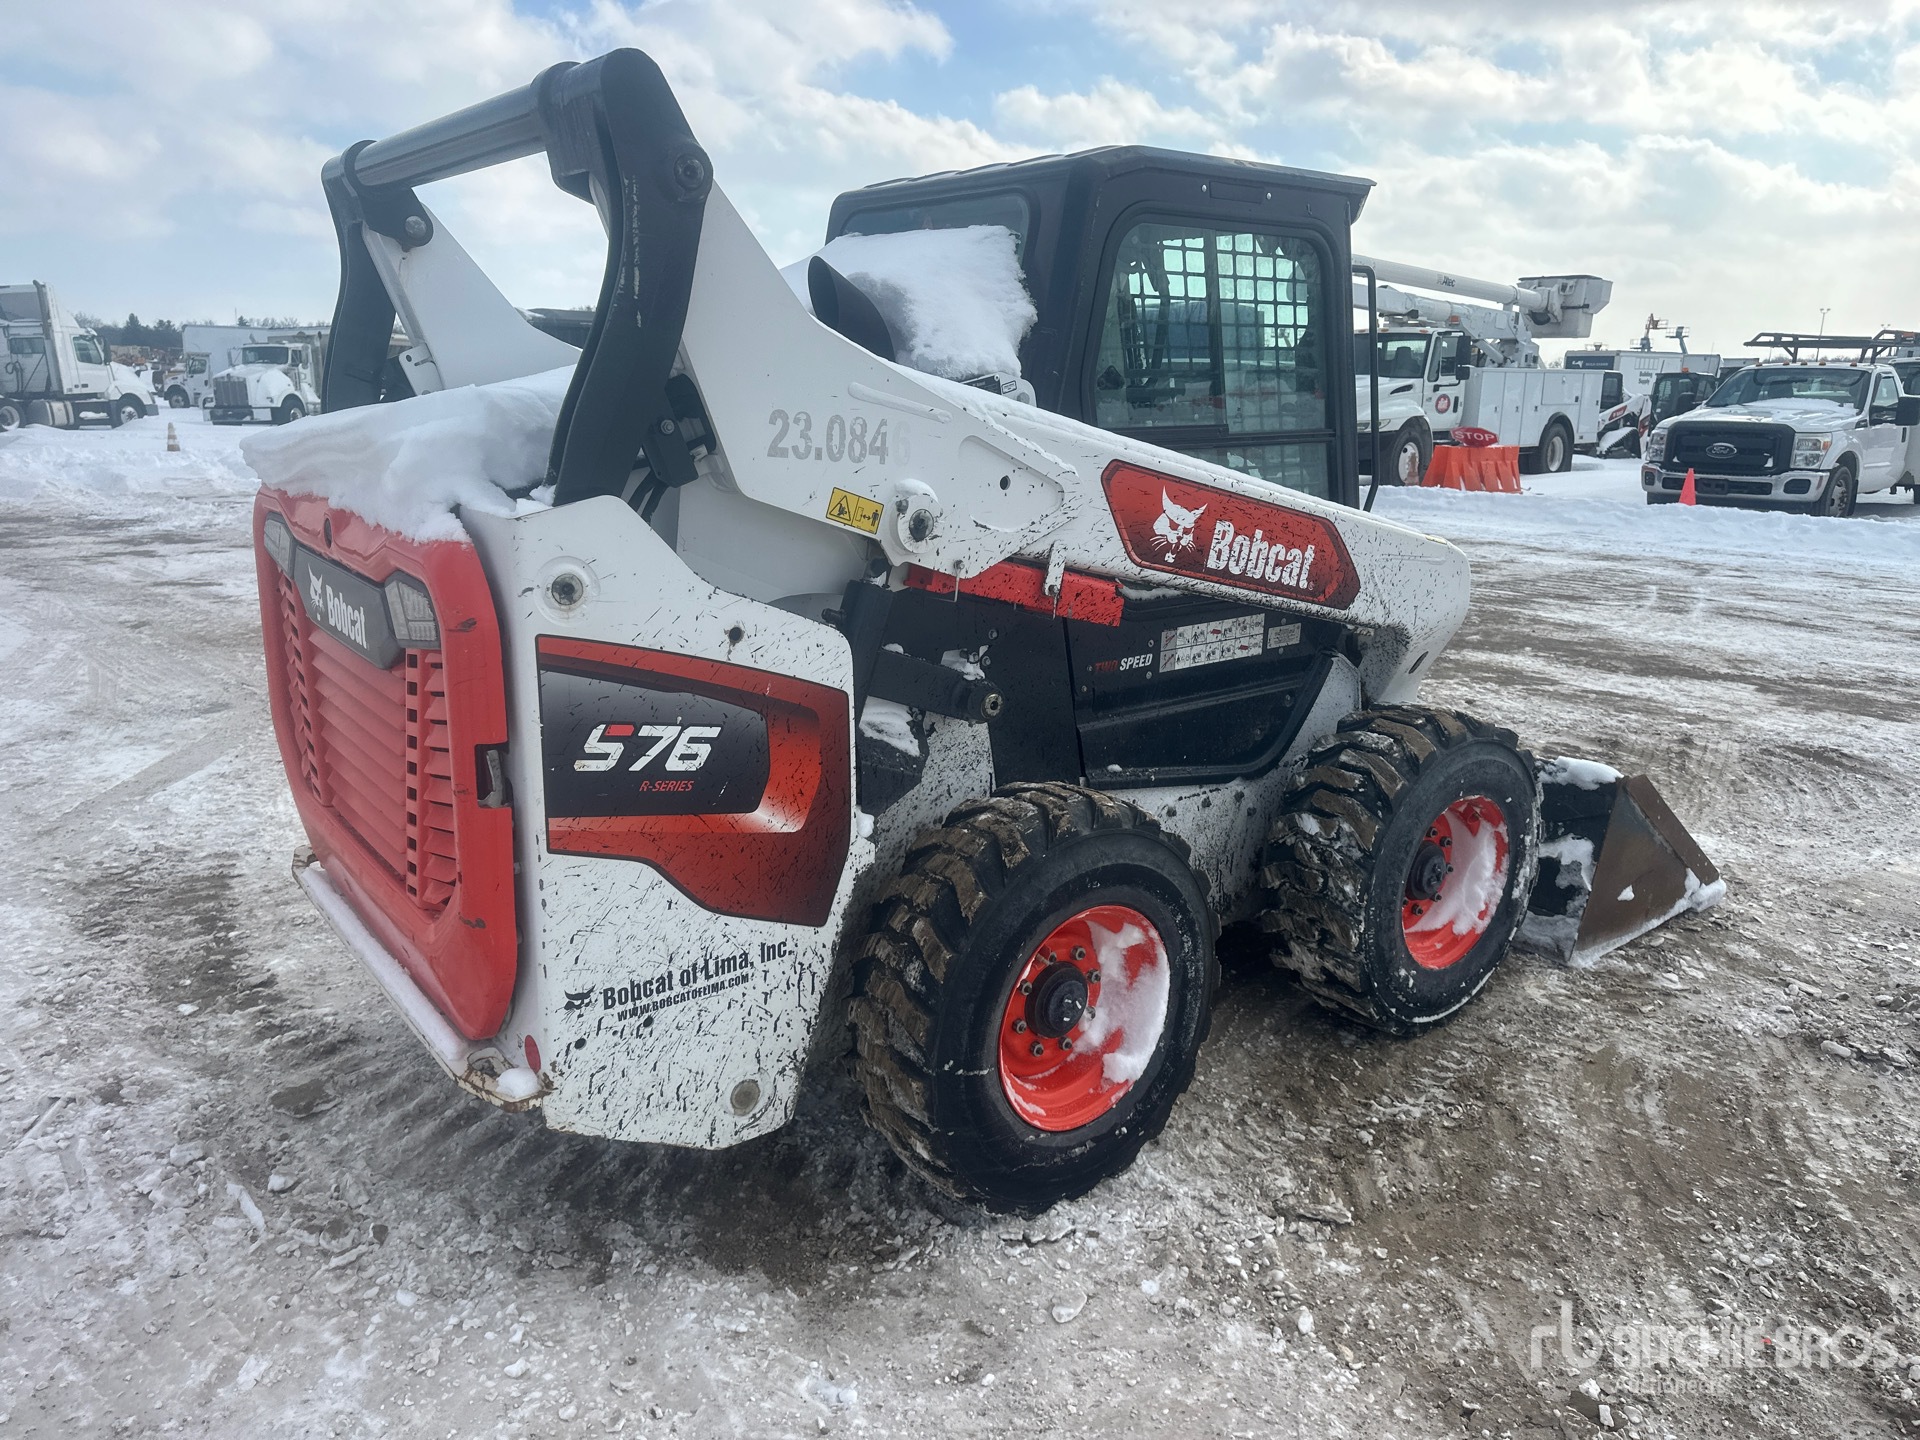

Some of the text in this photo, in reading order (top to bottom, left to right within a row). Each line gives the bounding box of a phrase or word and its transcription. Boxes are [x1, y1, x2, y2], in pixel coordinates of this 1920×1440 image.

[1454, 431, 1495, 442] STOP
[1711, 446, 1730, 454] Ford
[1206, 519, 1316, 590] Bobcat
[325, 584, 368, 649] Bobcat
[1095, 653, 1153, 672] TWO SPEED
[573, 724, 722, 772] S76
[639, 780, 695, 792] R-SERIES
[602, 940, 793, 1011] Bobcat of Lima, Inc.
[617, 973, 750, 1022] WWW.BOBCATOFLIMA.COM
